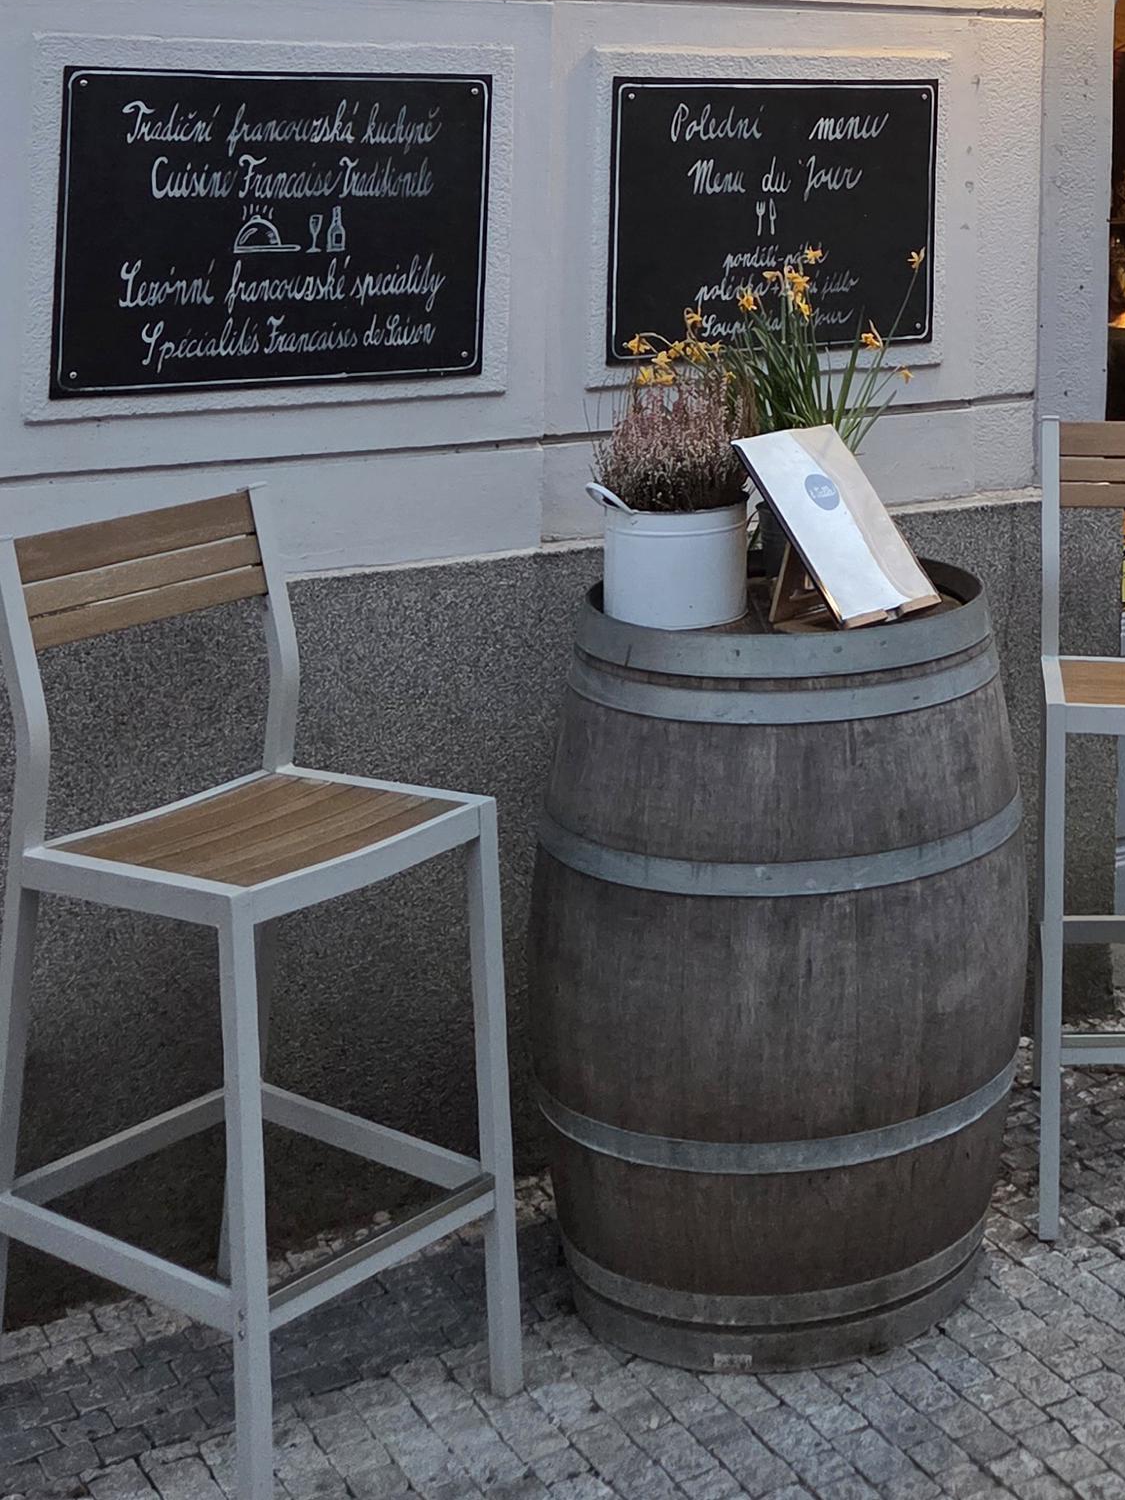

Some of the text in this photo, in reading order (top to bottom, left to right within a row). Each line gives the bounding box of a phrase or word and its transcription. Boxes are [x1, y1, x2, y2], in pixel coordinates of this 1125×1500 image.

[122, 98, 443, 157] Tradiční francouzská kuchyně
[670, 102, 890, 143] Polední menu
[151, 156, 236, 199] Cuisine
[687, 155, 863, 203] Menu du Jour
[224, 254, 352, 314] francouzské
[361, 313, 386, 347] de
